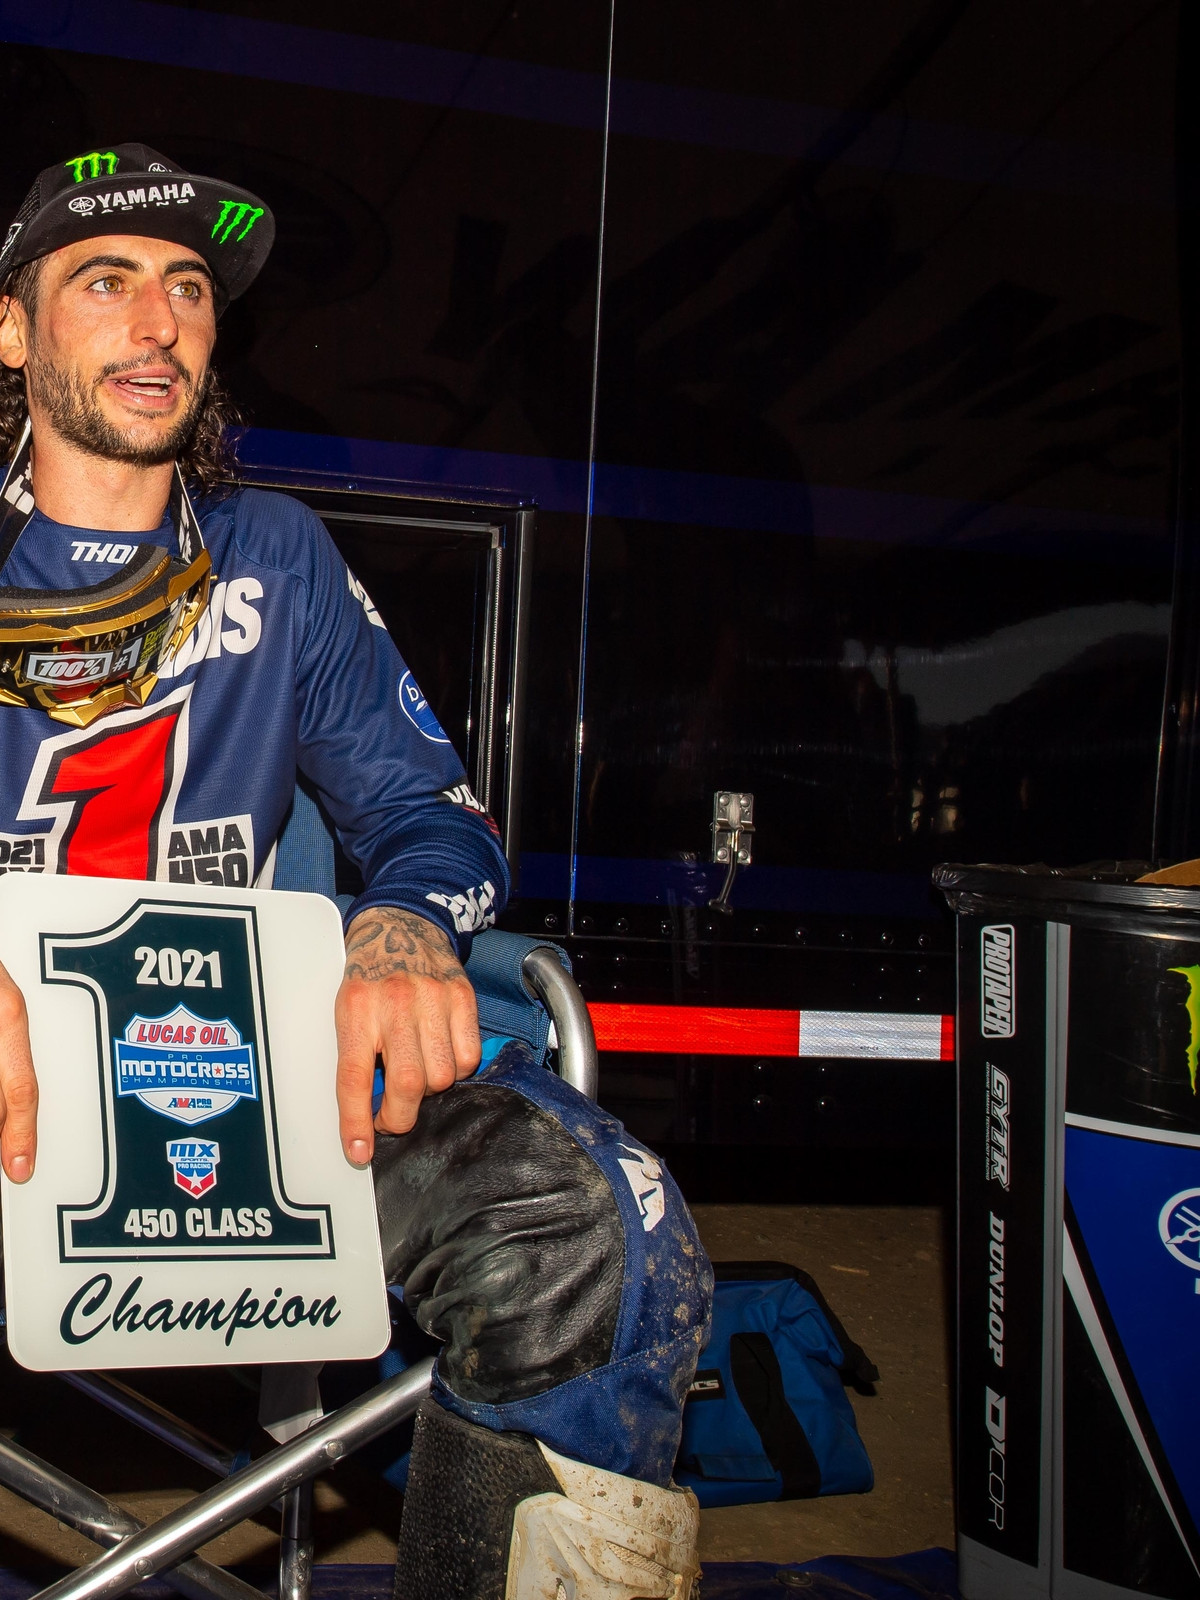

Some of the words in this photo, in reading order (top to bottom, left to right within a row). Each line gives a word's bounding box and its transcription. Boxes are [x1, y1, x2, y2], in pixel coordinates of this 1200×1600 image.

[96, 182, 195, 208] YAMAHA
[39, 658, 102, 677] 100%
[167, 823, 248, 859] AMA
[134, 947, 223, 989] 2021
[983, 927, 1011, 1036] PROTAPER
[136, 1024, 196, 1044] LUCAS
[121, 1060, 250, 1078] MOTOCROSS
[122, 1076, 251, 1086] CHAMPIONSHIP
[167, 1097, 196, 1108] AMA
[990, 1064, 1011, 1189] GYTR
[169, 1143, 216, 1157] MX
[124, 1210, 179, 1238] 450
[187, 1209, 273, 1237] CLASS
[988, 1211, 1005, 1368] DUNLOP
[60, 1272, 341, 1346] Champion
